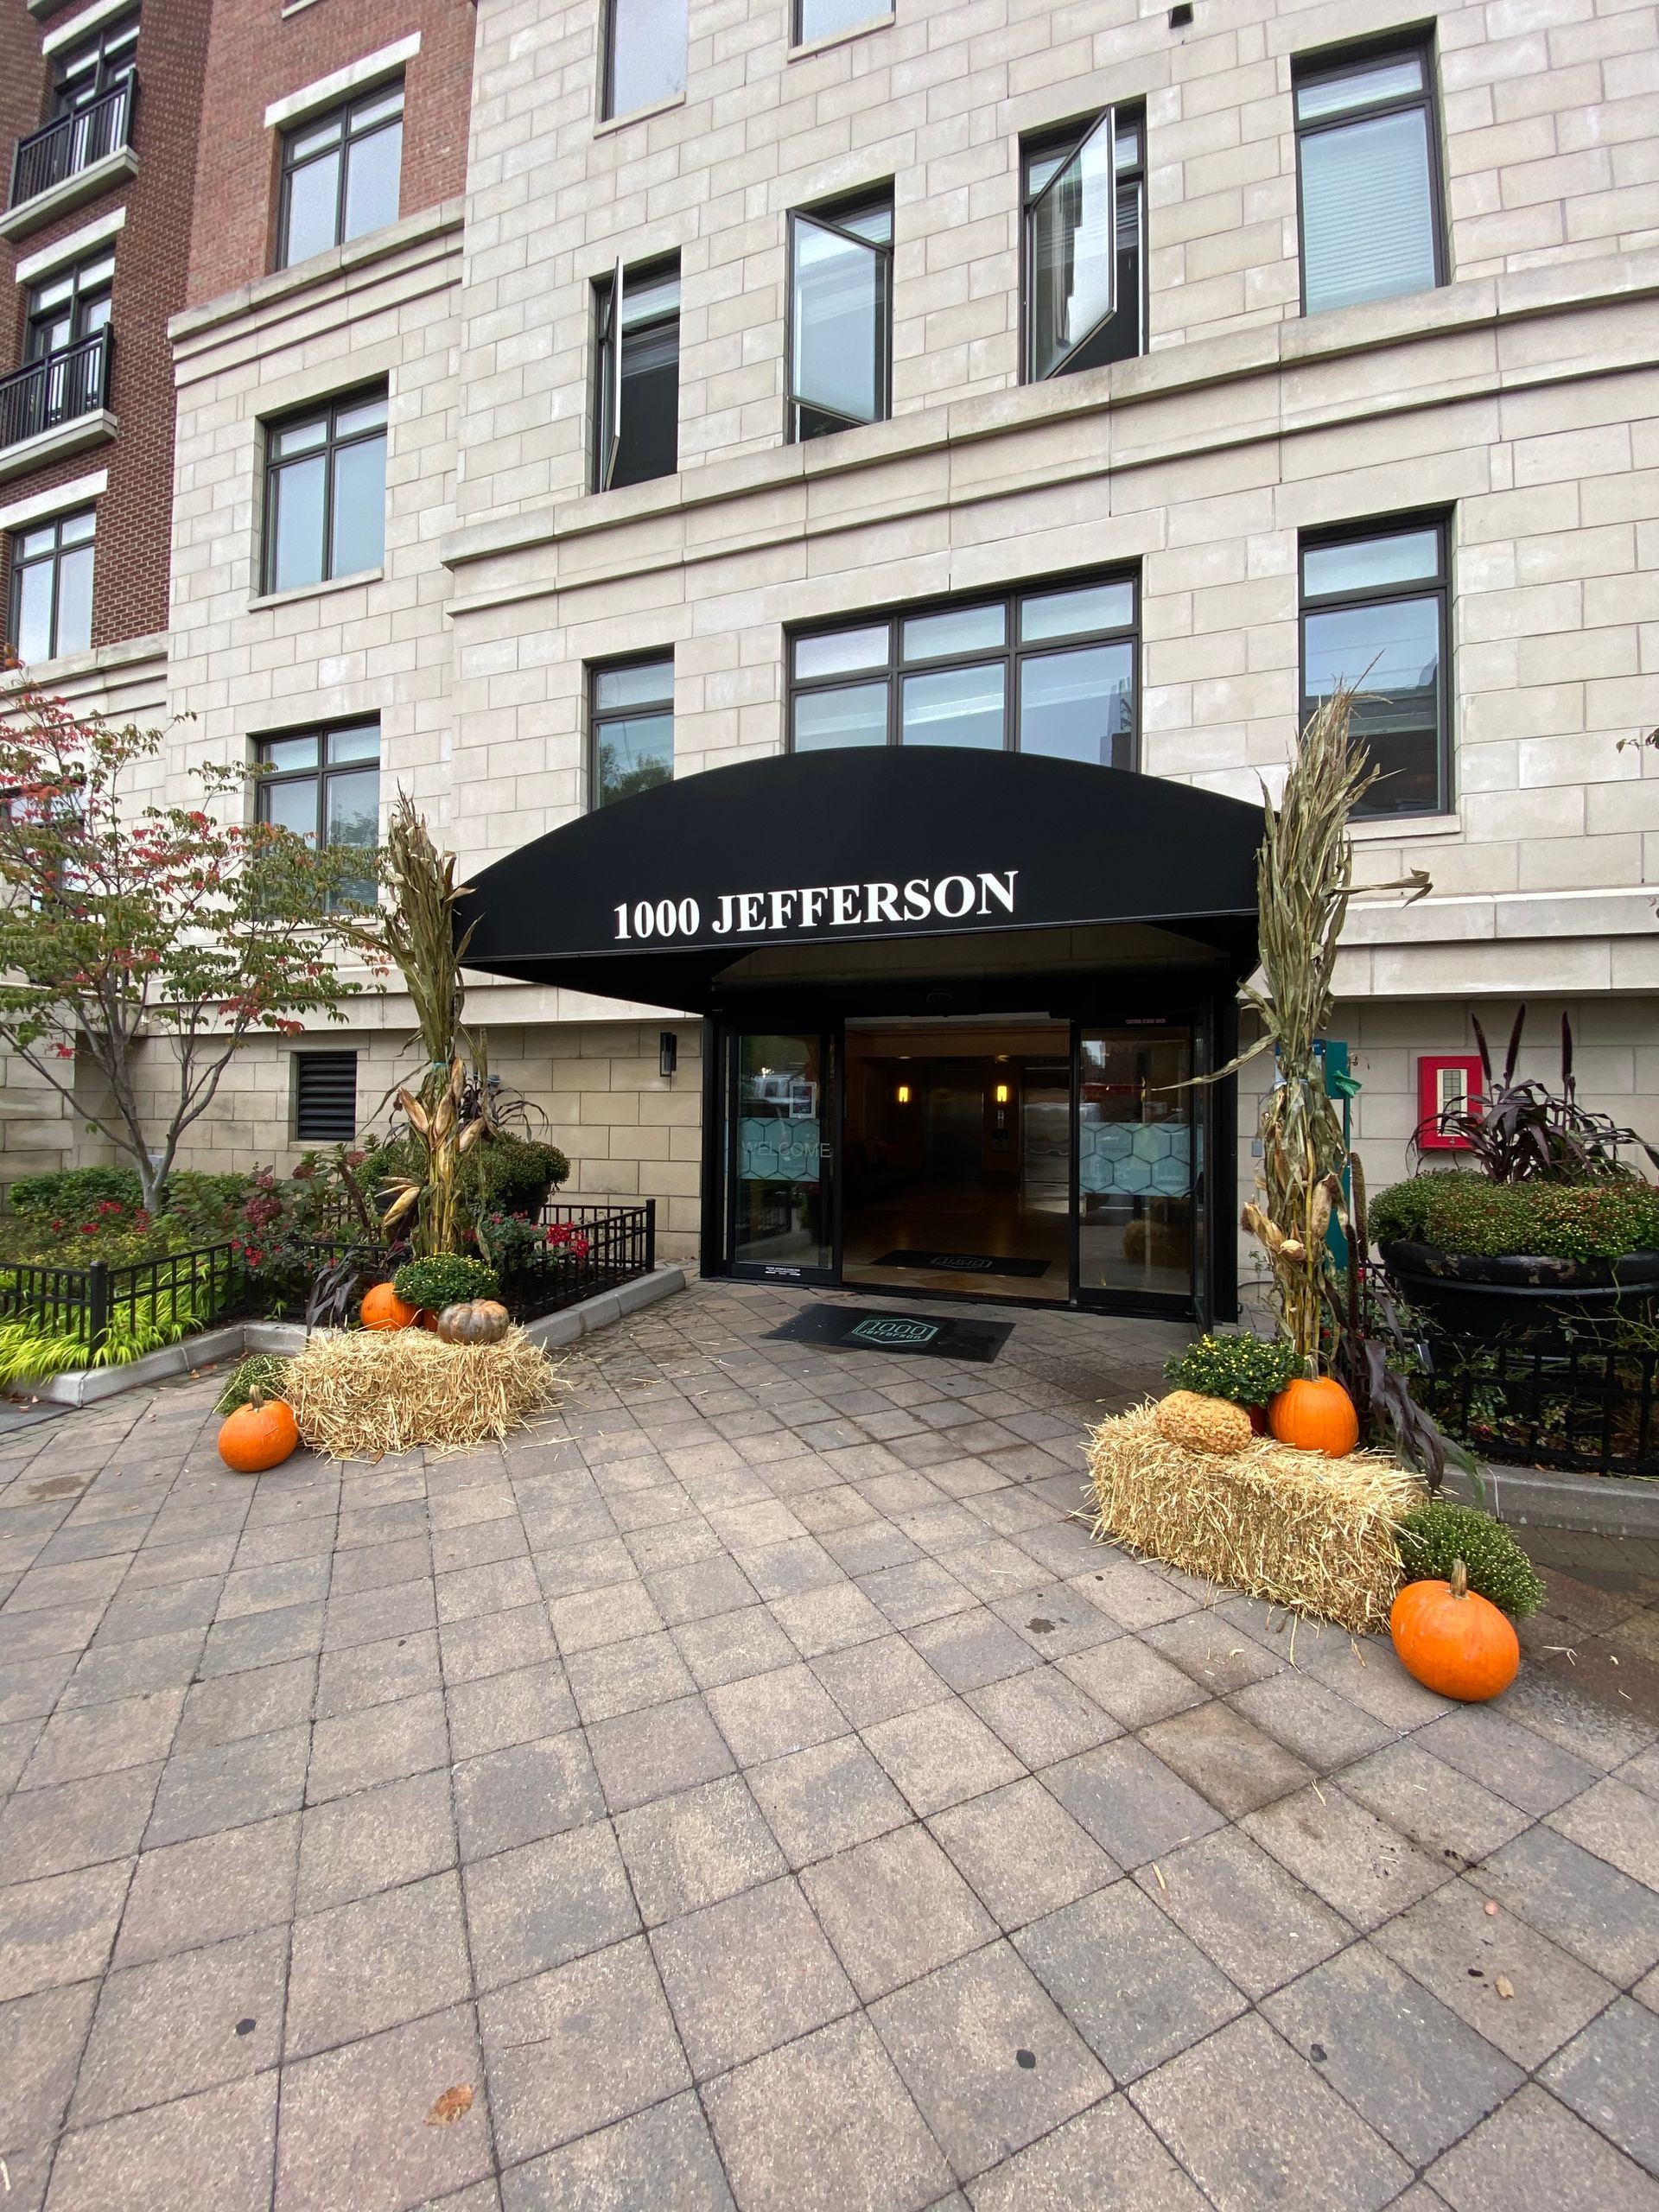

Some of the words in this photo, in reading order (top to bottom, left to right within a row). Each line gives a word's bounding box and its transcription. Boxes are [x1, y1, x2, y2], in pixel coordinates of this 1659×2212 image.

[613, 898, 700, 939] 1000
[711, 871, 1019, 933] JEFFERSON
[742, 1141, 831, 1158] WELCOME
[868, 1322, 926, 1335] 1000
